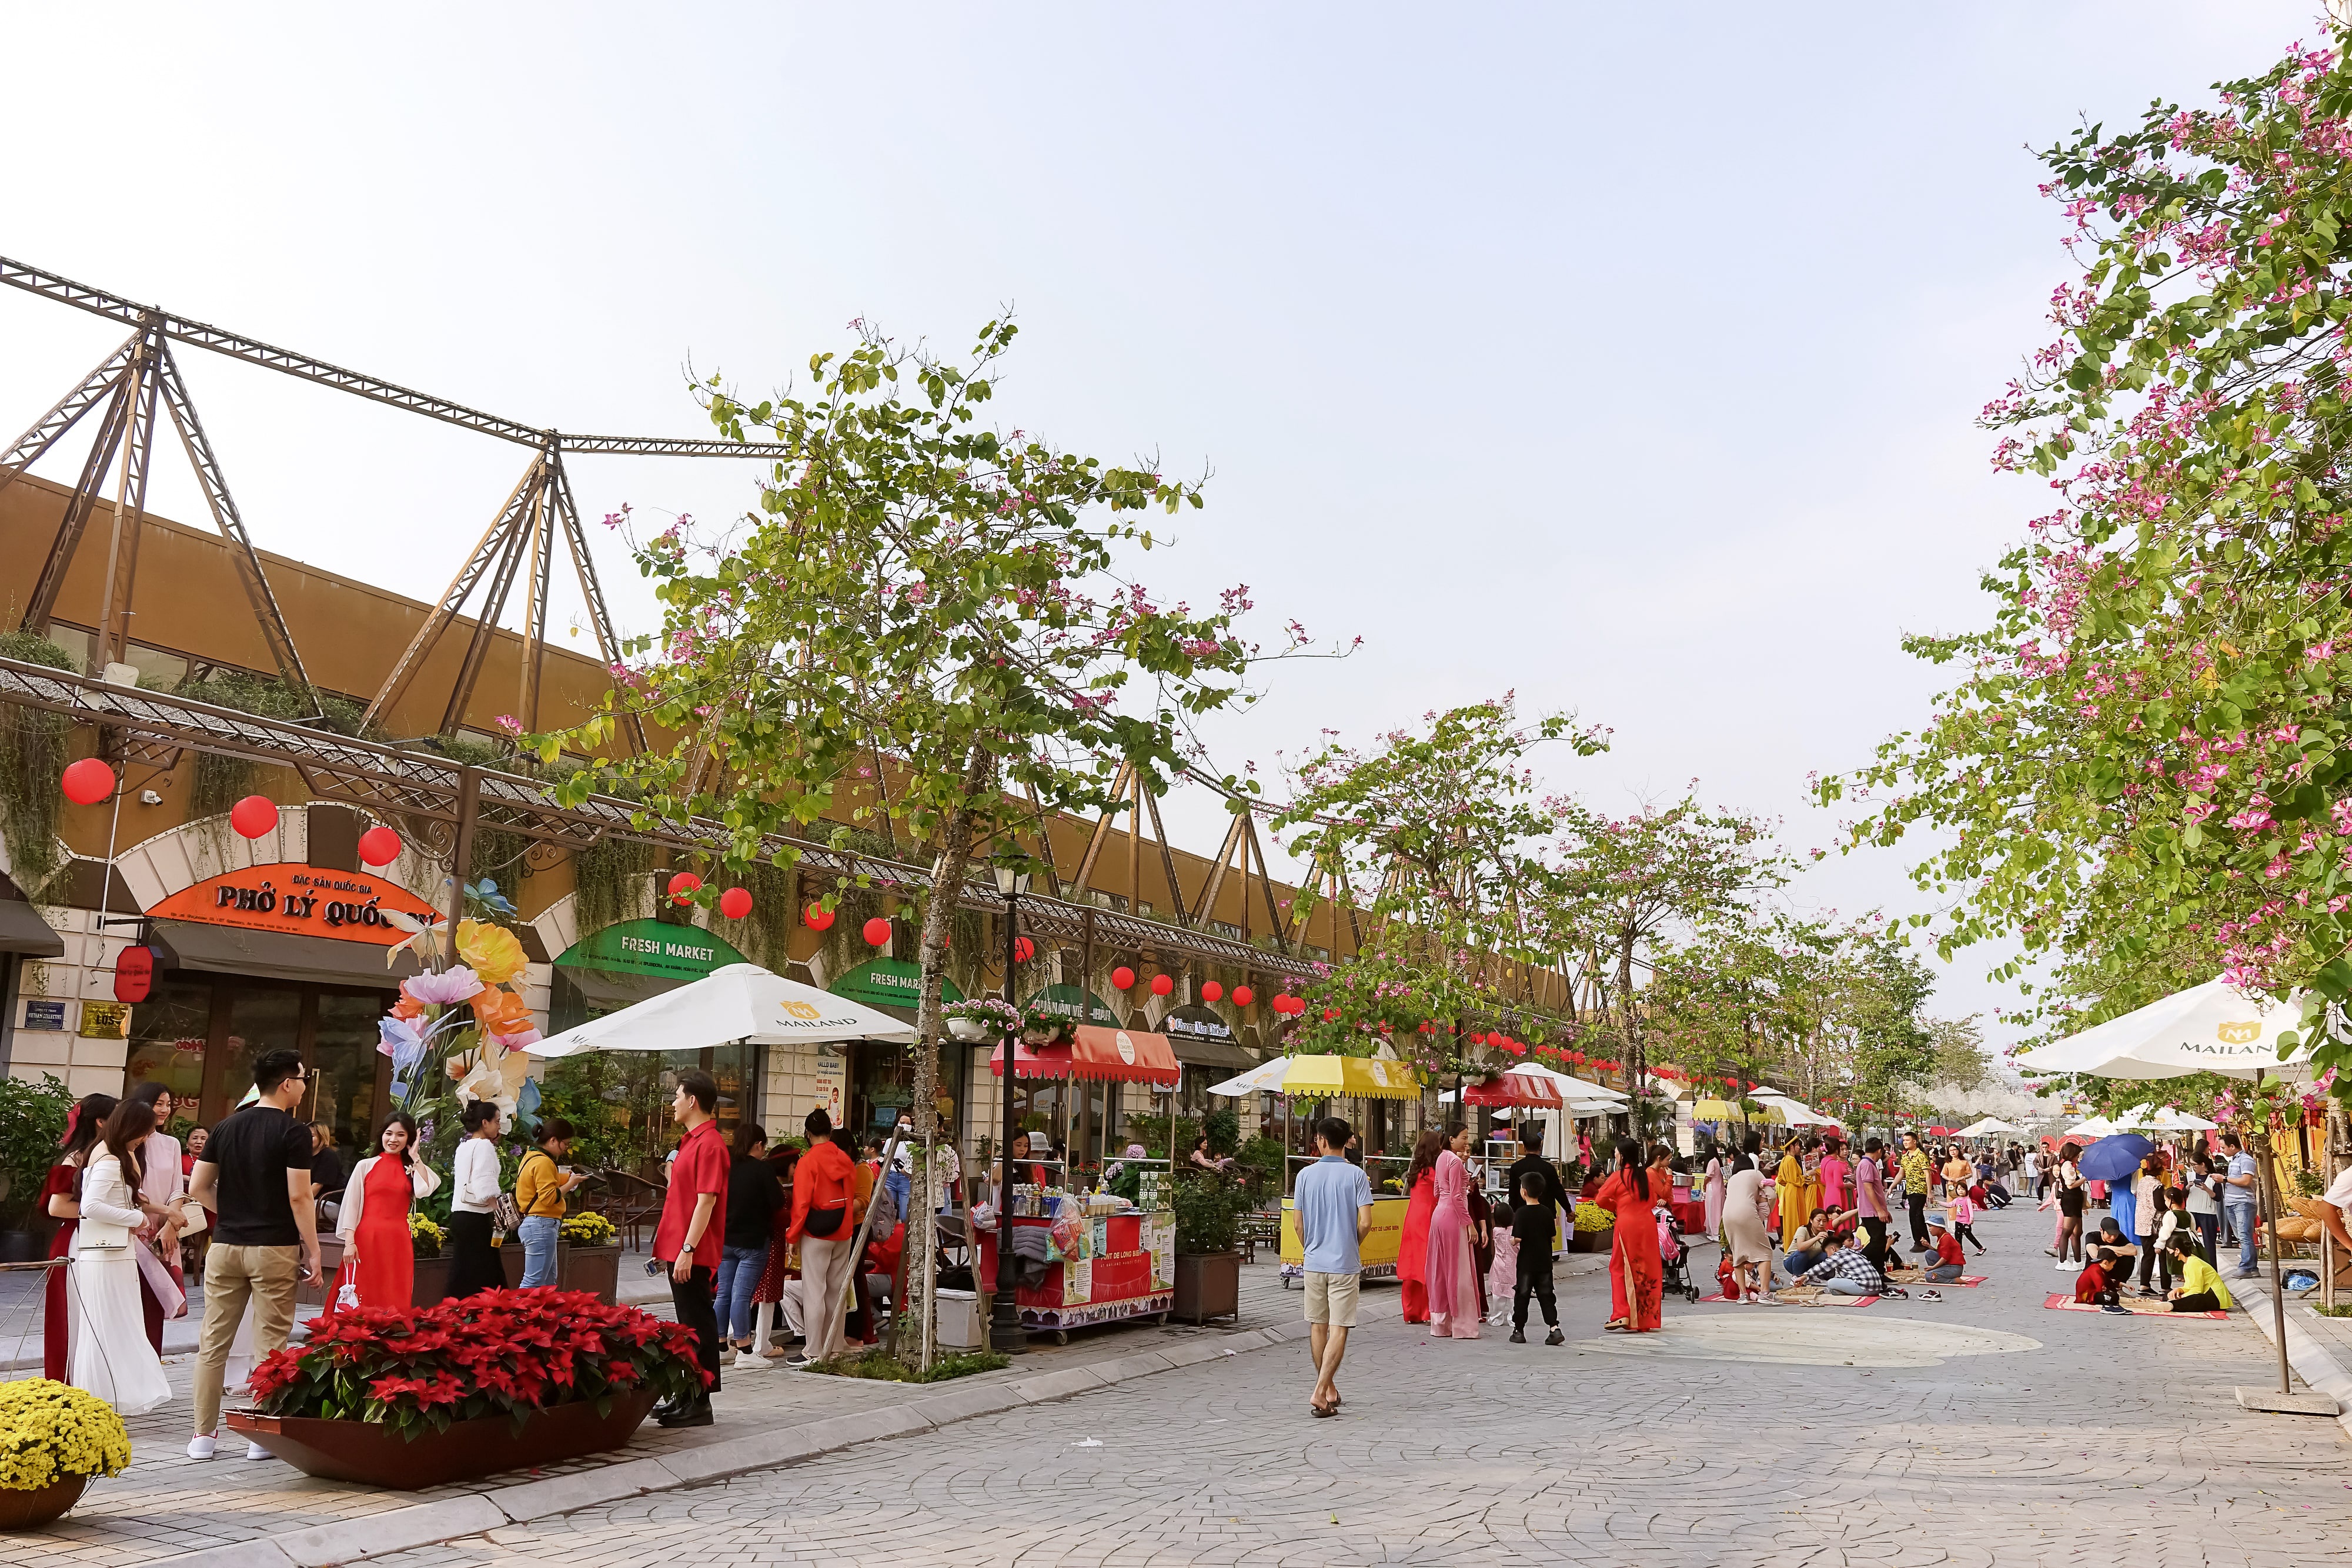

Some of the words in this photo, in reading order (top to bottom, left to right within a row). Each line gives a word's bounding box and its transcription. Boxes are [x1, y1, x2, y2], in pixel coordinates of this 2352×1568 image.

[292, 874, 310, 887] ĐẶC
[312, 876, 331, 888] SẢN
[333, 879, 356, 892] QUỐC
[358, 884, 372, 894] GIA
[216, 881, 276, 912] PHỞ
[283, 889, 318, 918] LÝ
[622, 936, 660, 954] FRESH
[666, 942, 714, 961] MARKET
[870, 972, 897, 987] FRESH
[900, 977, 921, 990] MAR
[776, 1018, 857, 1027] MAILAND
[1177, 1018, 1195, 1035] Choong
[1208, 1024, 1227, 1037] Chicken
[2180, 1042, 2273, 1054] MAILAN
